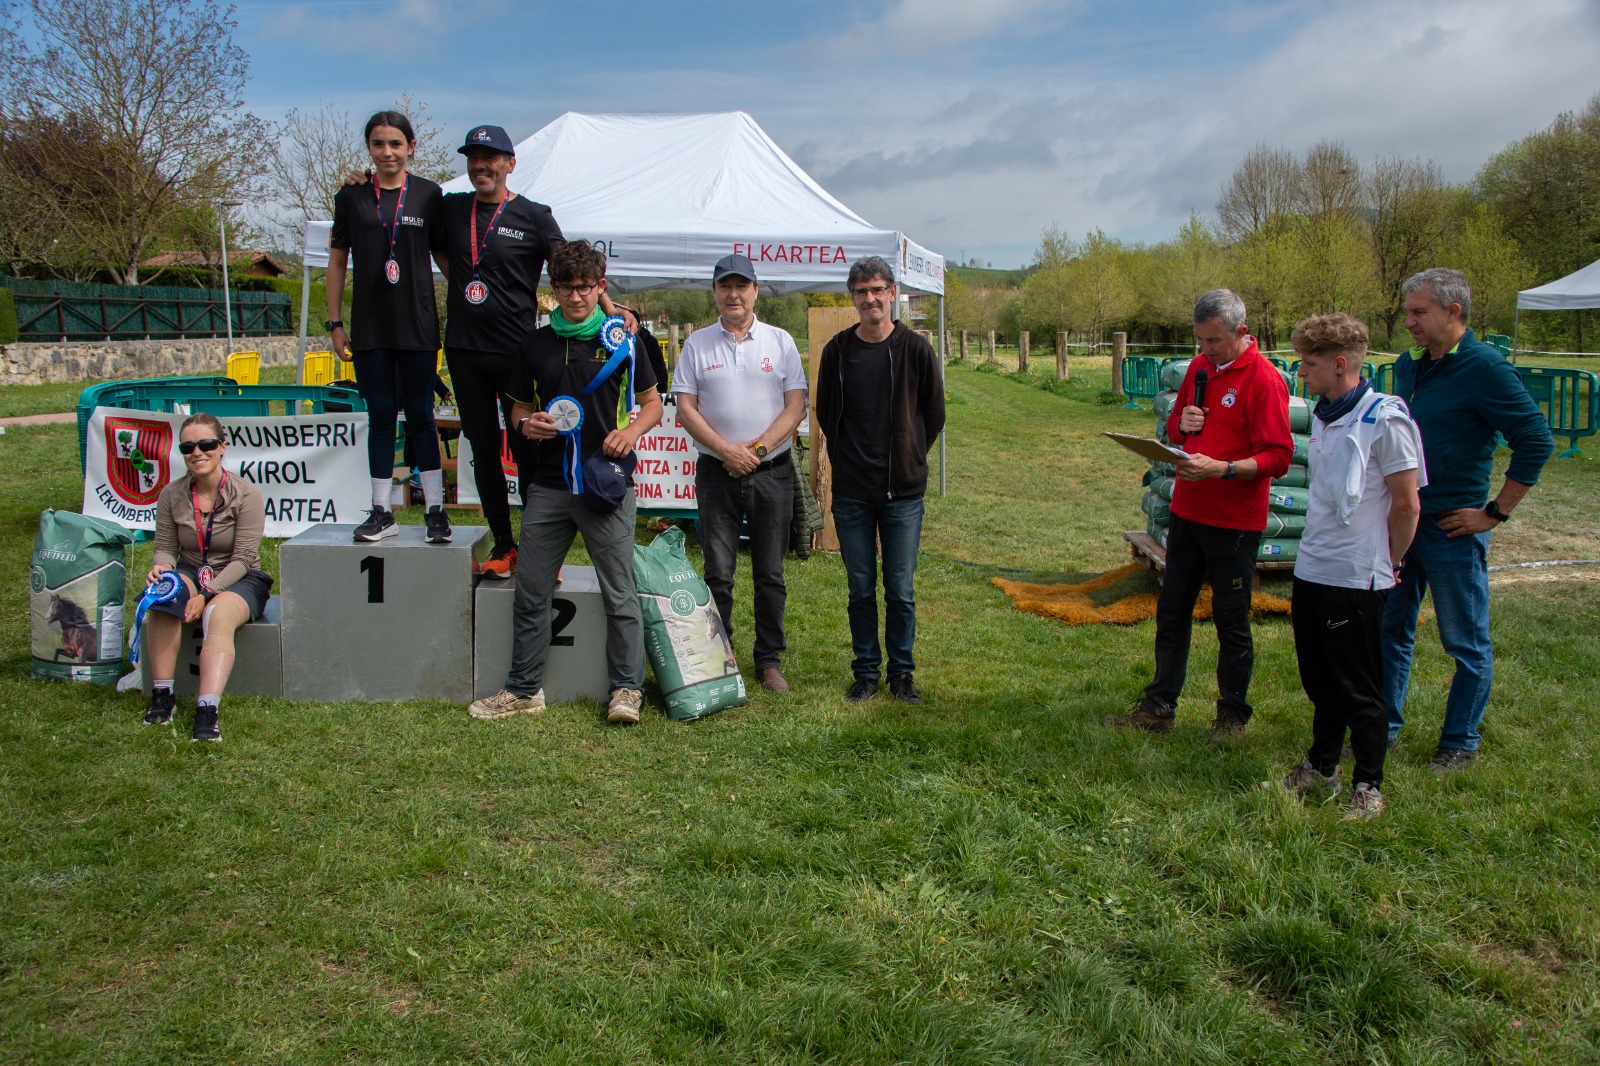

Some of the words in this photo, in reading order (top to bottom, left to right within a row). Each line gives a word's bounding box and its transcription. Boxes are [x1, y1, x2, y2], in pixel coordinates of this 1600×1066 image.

[498, 227, 524, 237] IRULEN
[222, 423, 356, 447] KUNBERRI
[240, 461, 316, 484] KIROL
[95, 483, 157, 522] LEKUNBERR
[265, 498, 337, 523] ARTEA
[360, 555, 385, 603] 1
[550, 598, 577, 646] 2
